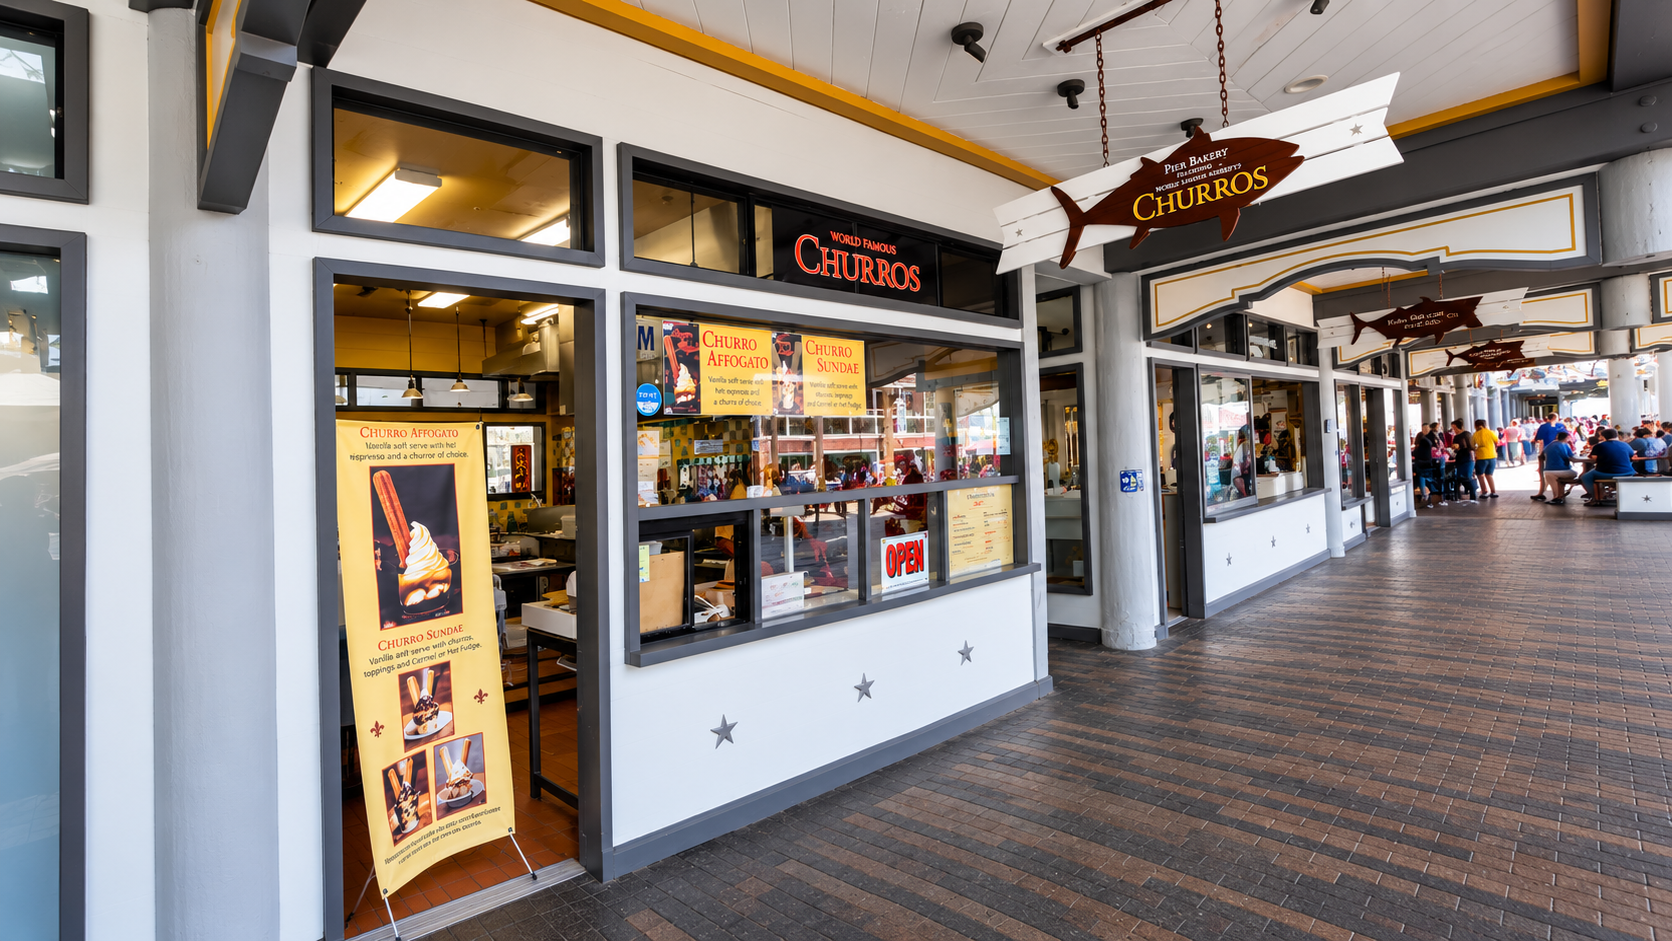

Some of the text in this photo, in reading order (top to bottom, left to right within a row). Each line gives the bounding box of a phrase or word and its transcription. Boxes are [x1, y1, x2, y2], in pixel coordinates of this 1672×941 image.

[1164, 148, 1228, 175] PIER BAKERY
[1132, 165, 1268, 221] CHURROS
[830, 230, 896, 255] WORLD FAMOUS
[794, 234, 920, 292] CHURROS
[638, 326, 654, 350] M
[702, 330, 757, 351] CHURRO
[806, 340, 852, 358] CHURRO
[707, 350, 768, 370] AFFOGATO
[817, 358, 860, 374] SUNDAE
[360, 426, 458, 438] CHURRO AFFOGATO
[387, 452, 401, 460] and
[446, 450, 469, 458] choice.
[886, 539, 924, 578] OPEN
[378, 624, 464, 651] CHURRO SUNDAE
[364, 664, 396, 678] toppings
